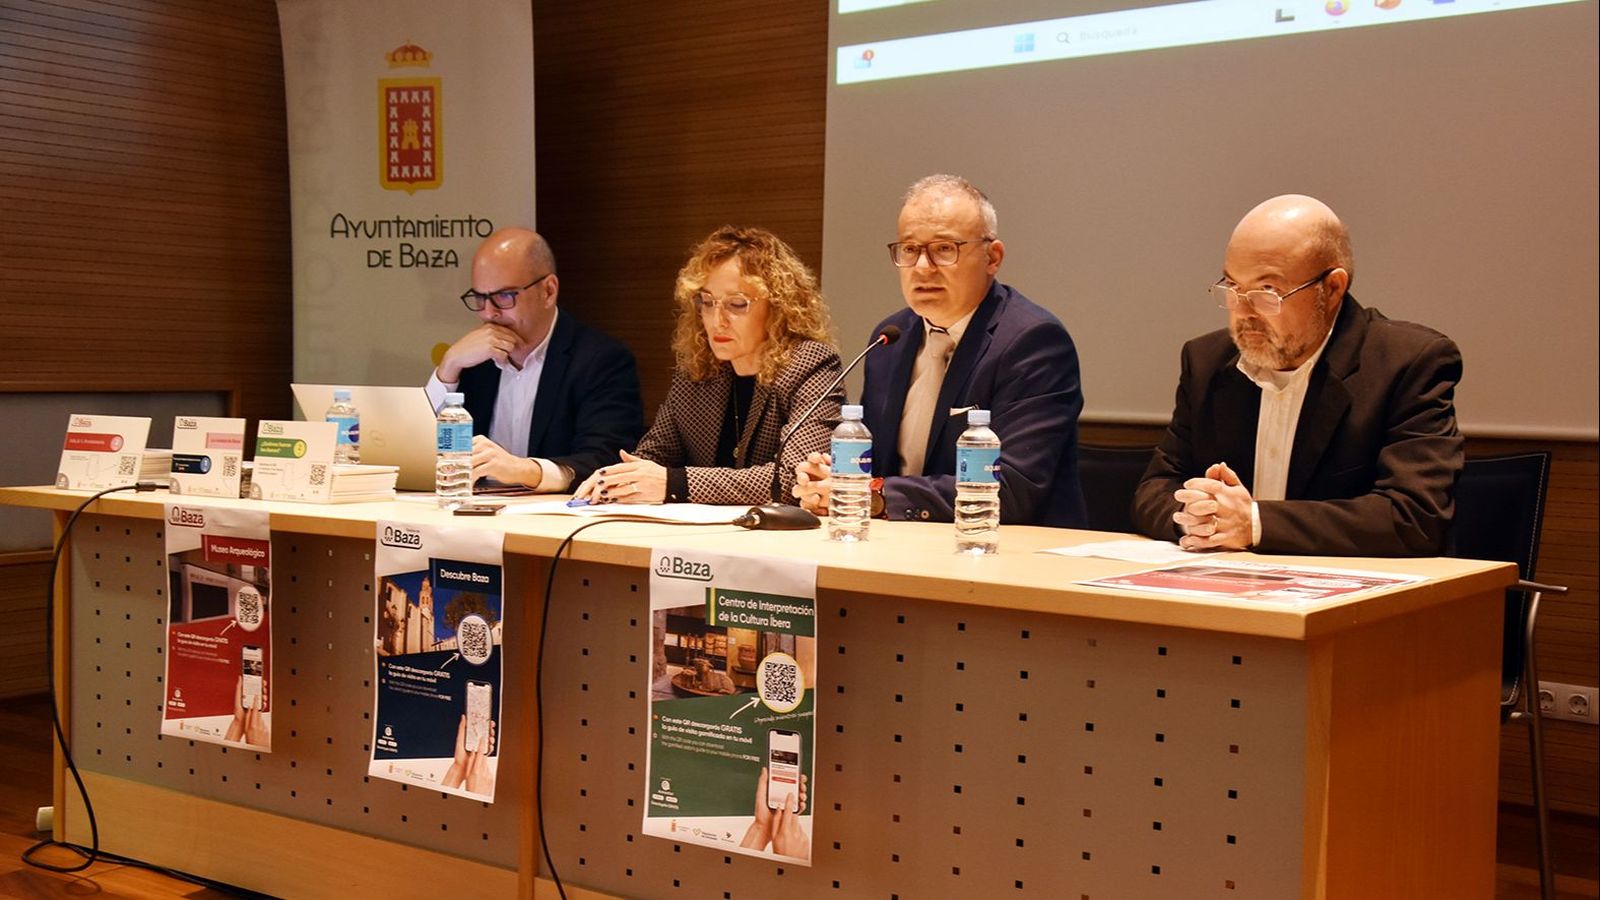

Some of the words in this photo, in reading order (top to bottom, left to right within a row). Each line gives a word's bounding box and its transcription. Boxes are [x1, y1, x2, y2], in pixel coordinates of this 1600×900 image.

[181, 511, 204, 524] Baza
[394, 529, 420, 545] Baza
[211, 544, 229, 554] Museo
[672, 557, 710, 577] Baza
[440, 568, 471, 581] Descubre
[472, 572, 489, 583] Baza
[718, 596, 745, 608] Centro
[747, 598, 757, 610] de
[759, 600, 814, 617] Interpretación
[718, 611, 729, 622] de
[730, 612, 738, 623] la
[739, 613, 768, 625] Cultura
[721, 725, 742, 735] GRATIS
